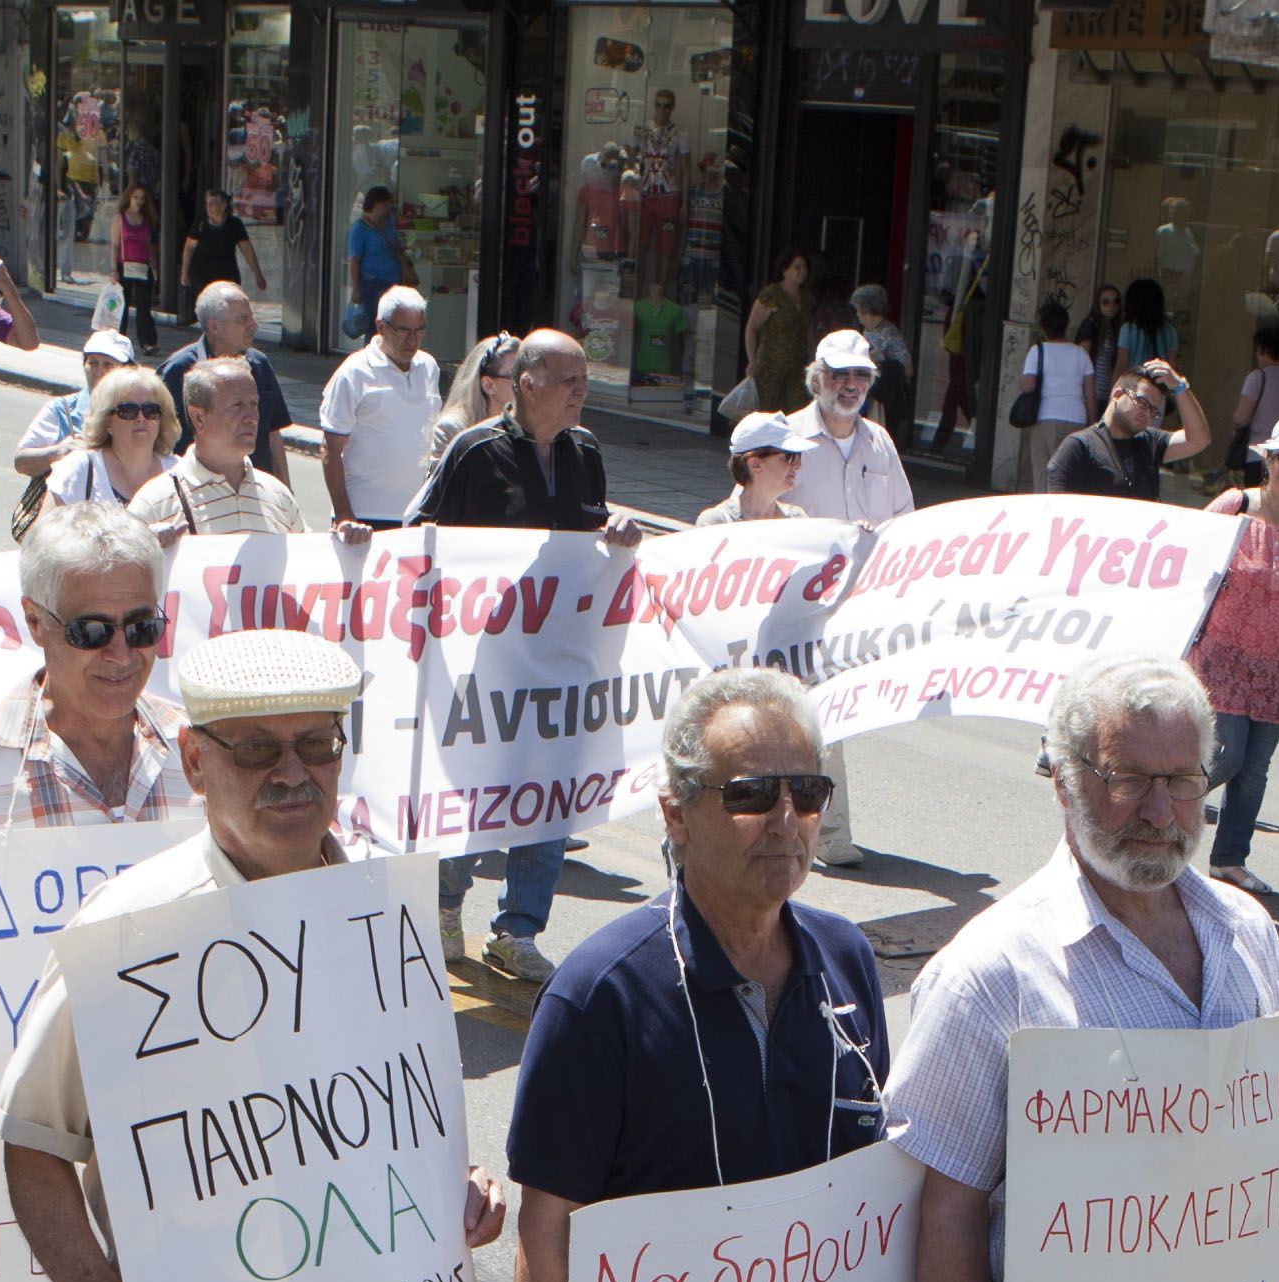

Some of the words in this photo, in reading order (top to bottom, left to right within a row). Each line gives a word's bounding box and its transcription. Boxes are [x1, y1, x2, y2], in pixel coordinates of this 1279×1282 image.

[516, 93, 536, 147] out
[202, 549, 559, 663] Συντάξεων
[851, 511, 1028, 599] Δωρεάν
[1040, 516, 1187, 597] Υγεία
[917, 665, 1068, 704] ΕΝΟΤΗ
[397, 767, 630, 842] ΜΕΙΖΟΝΟΣ
[117, 918, 308, 1061] ΣΟΥ
[347, 903, 446, 1014] ΤΑ
[130, 1041, 447, 1213] ΠΑΙΡΝΟΥΝ
[235, 1163, 439, 1282] ΟΛΑ
